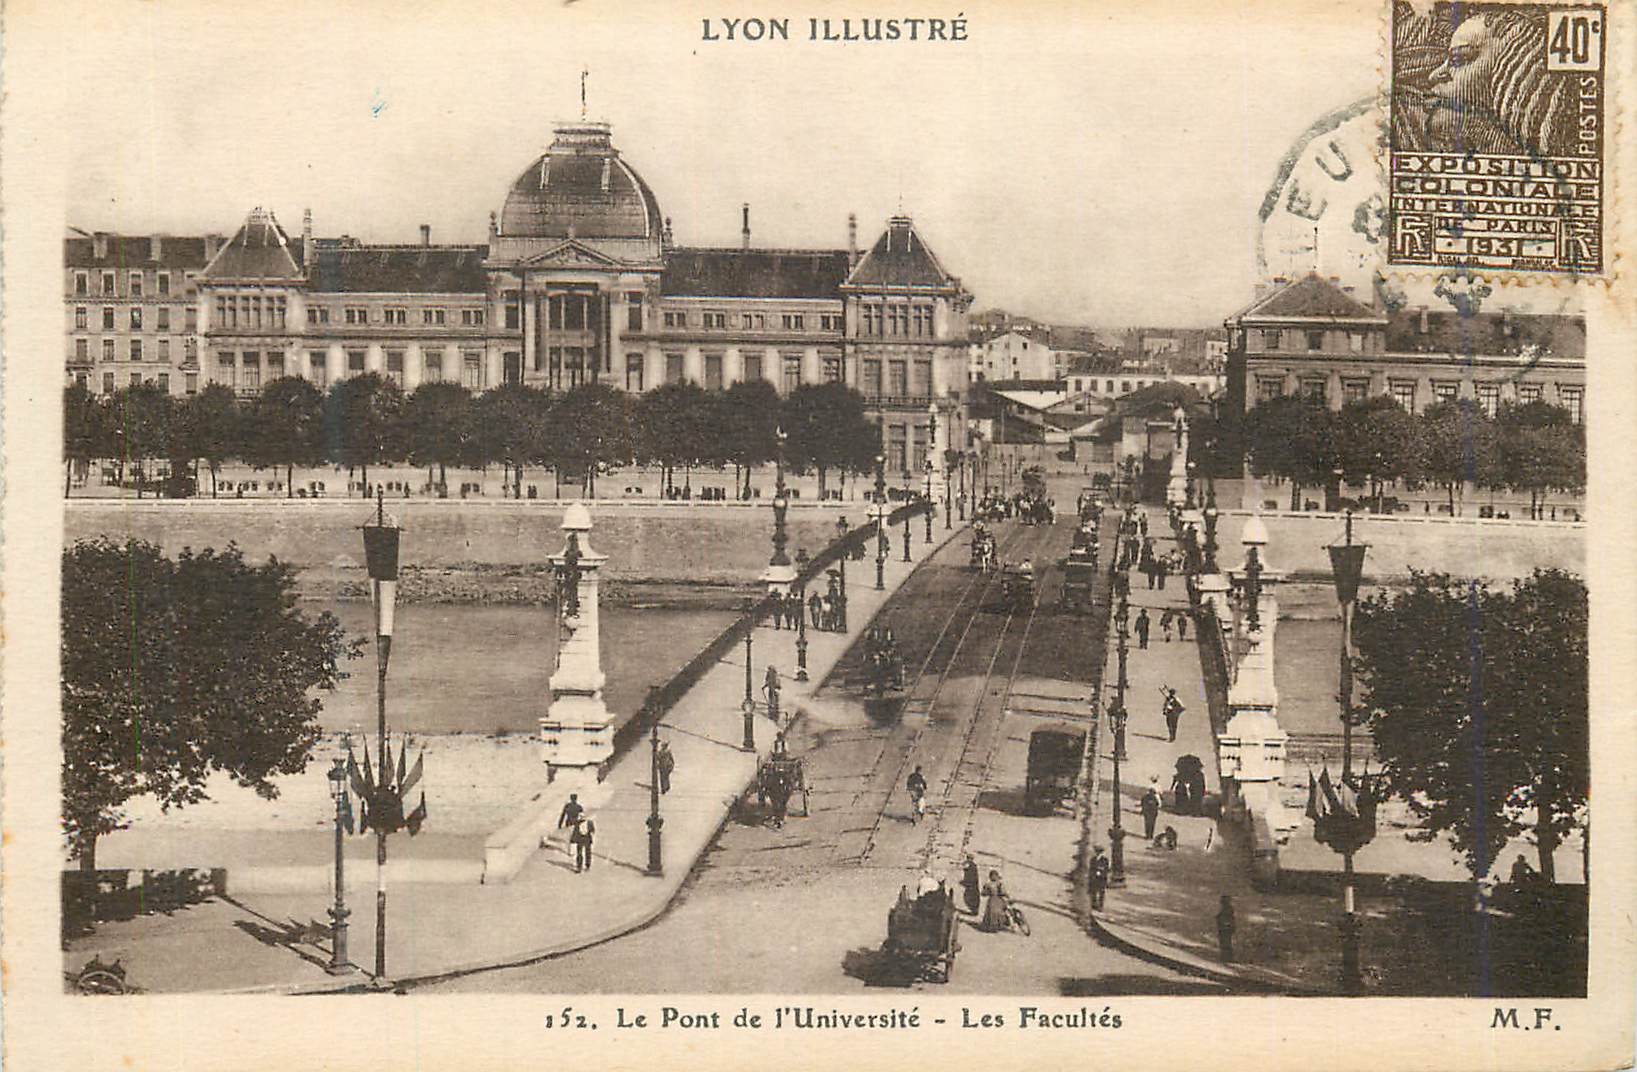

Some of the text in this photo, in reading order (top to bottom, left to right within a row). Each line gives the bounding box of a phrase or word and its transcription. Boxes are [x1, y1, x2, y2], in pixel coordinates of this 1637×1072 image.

[1579, 76, 1597, 155] POSTES
[1393, 156, 1598, 179] EXPOSITION
[1395, 177, 1597, 199] COLONIALE
[1393, 198, 1598, 218] INTERNATIONALE
[1487, 219, 1552, 234] PARIS
[1467, 237, 1521, 257] 1931
